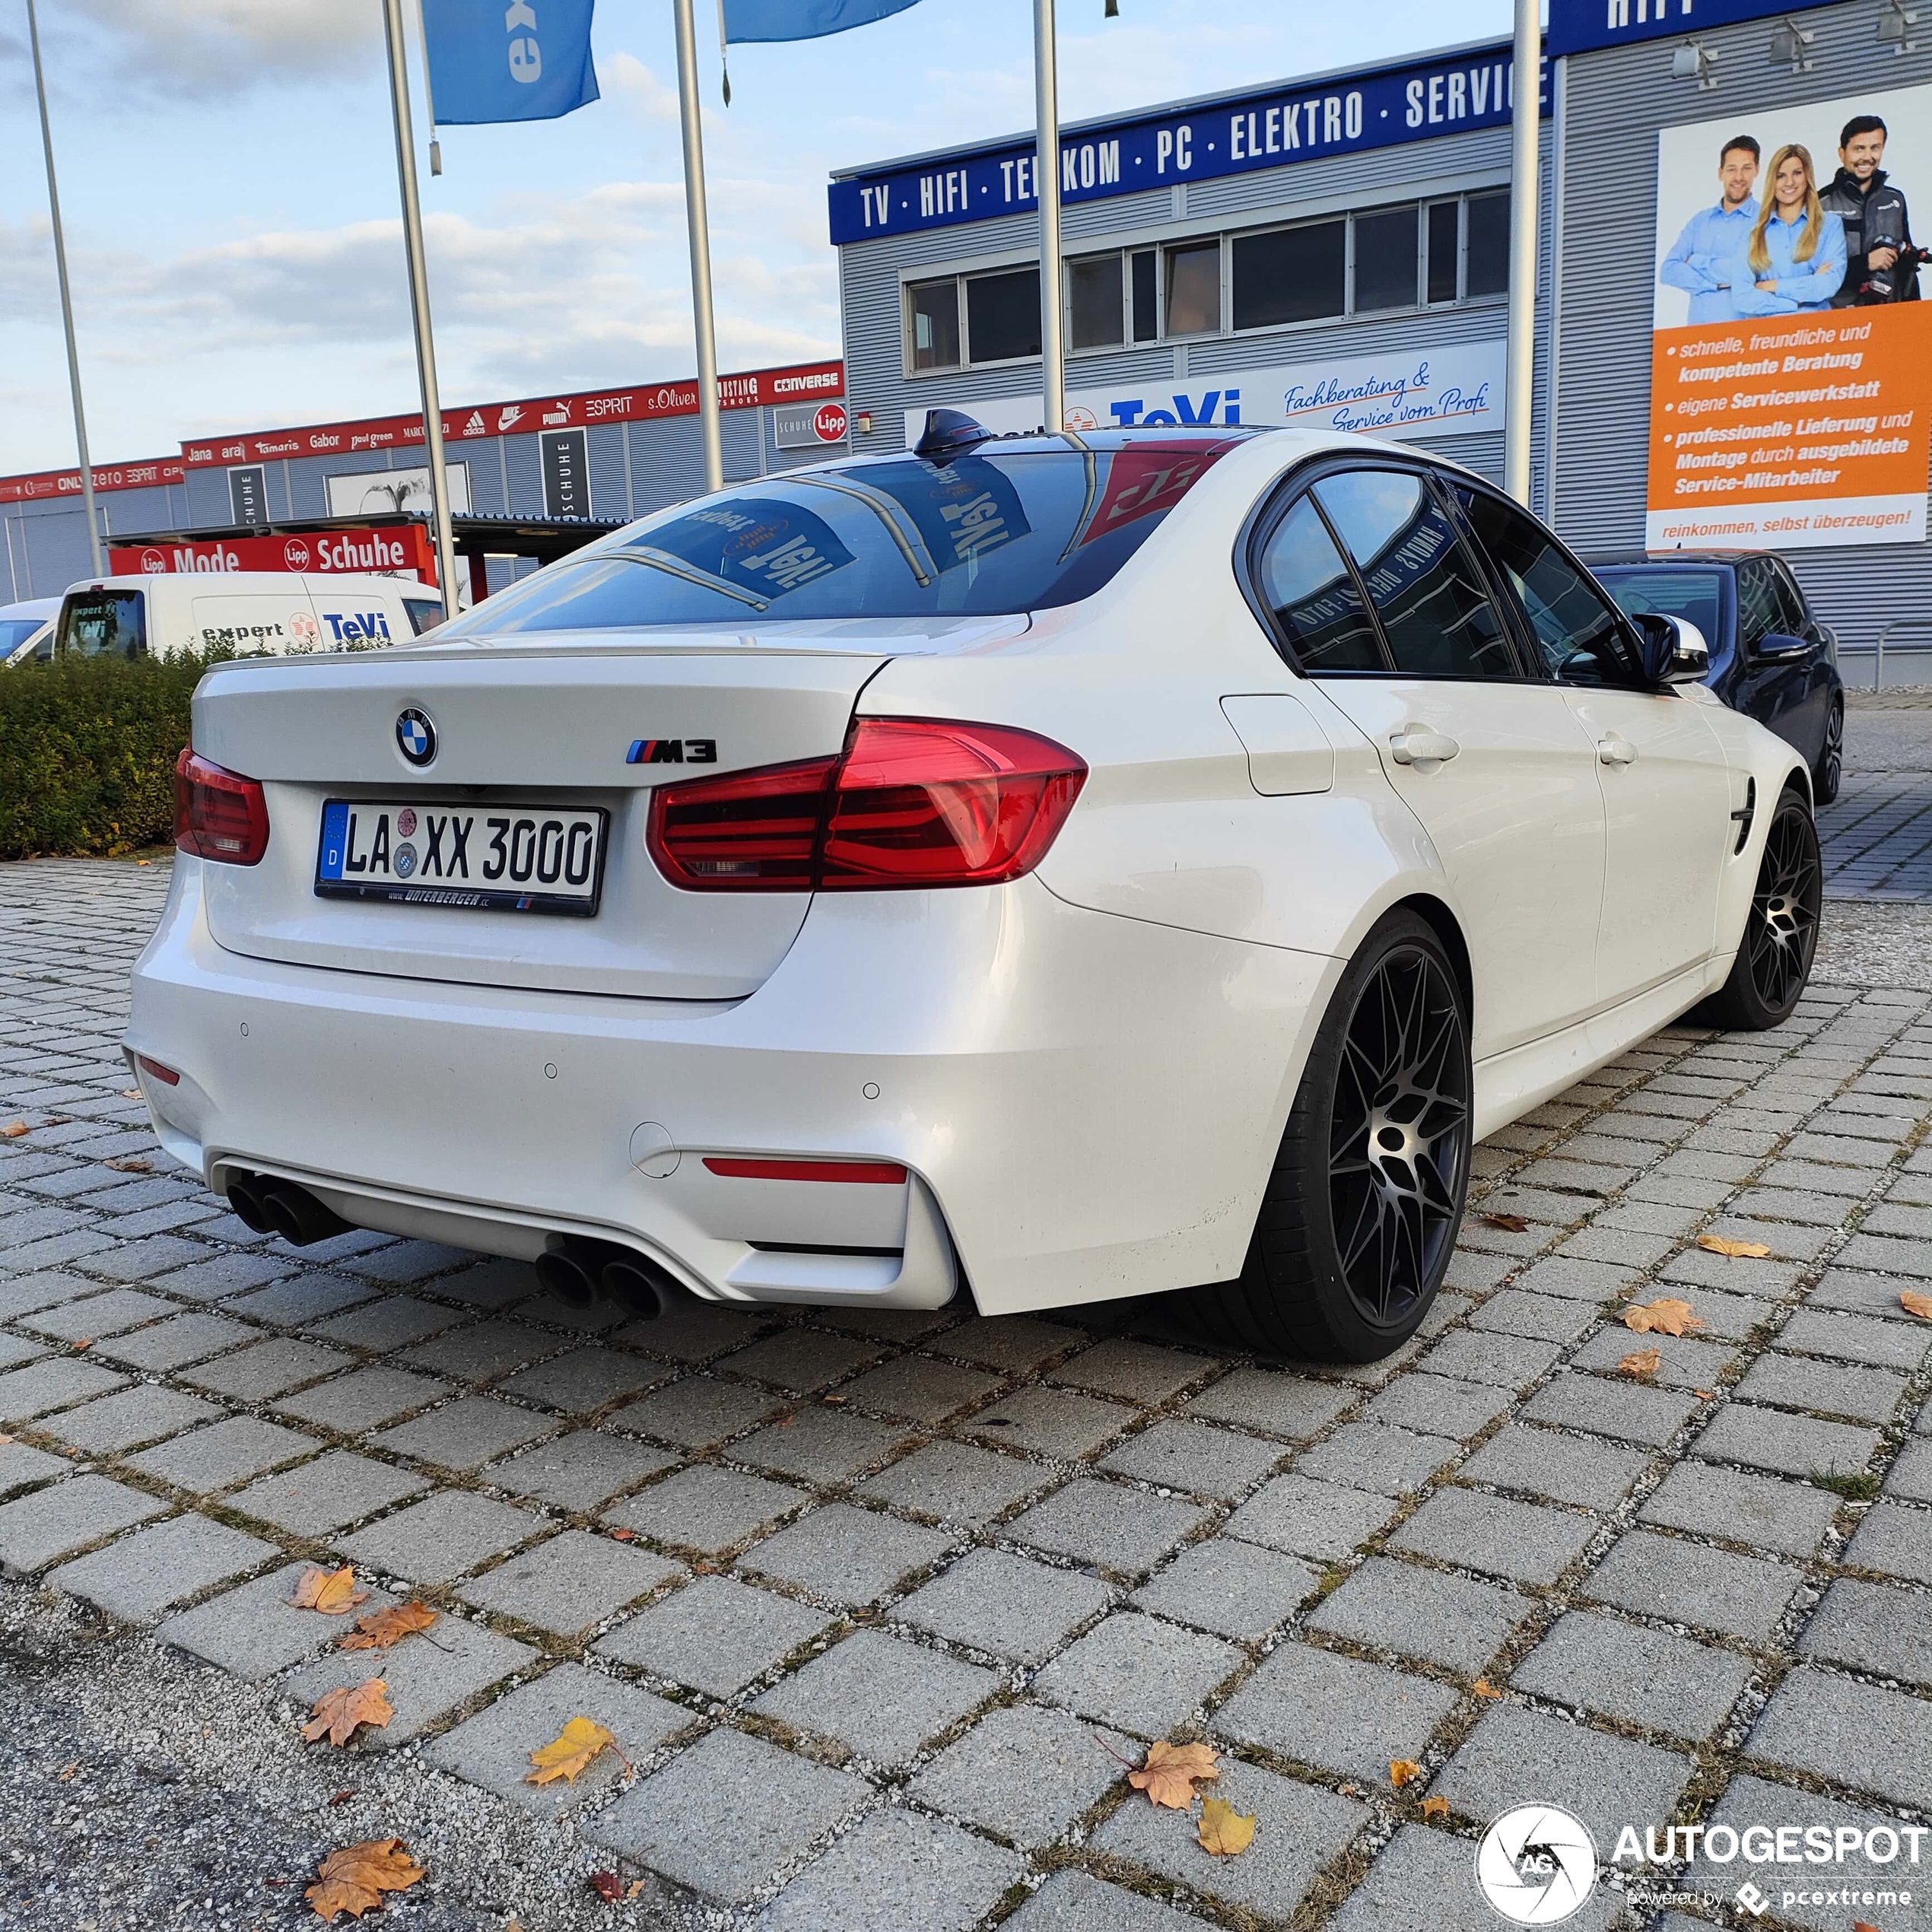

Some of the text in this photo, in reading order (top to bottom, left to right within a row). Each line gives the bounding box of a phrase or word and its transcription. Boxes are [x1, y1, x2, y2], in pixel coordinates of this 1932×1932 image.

[860, 184, 889, 227] TV
[920, 170, 968, 217] HIFI
[1000, 140, 1120, 202] TEKOM
[1157, 126, 1193, 174] PC
[1231, 91, 1363, 160] ELEKTRO
[1679, 323, 1871, 358] schnelle, freundliche und
[774, 372, 838, 392] CONVERSE
[1679, 351, 1864, 383] kompetente Beratung
[648, 389, 696, 410] s.Oliver
[1284, 362, 1430, 408] Fachberatung &
[1677, 380, 1880, 416] eigene Servicewerkstatt
[502, 405, 520, 420] NIKE
[542, 412, 567, 425] PUMA
[586, 396, 633, 417] ESPRIT
[1332, 383, 1489, 431] Service vom Profi
[462, 426, 485, 436] adidas
[779, 414, 845, 433] SCHUHE Lipp
[1676, 410, 1913, 448] professionelle Lieferung und
[188, 448, 212, 462] Jana
[221, 446, 241, 458] ara
[310, 433, 339, 448] Gabor
[351, 432, 369, 450] paul
[370, 432, 392, 448] green
[1676, 437, 1909, 472] Montage durch ausgebildete
[92, 472, 122, 486] zero
[126, 467, 157, 483] ESPRIT
[558, 443, 574, 512] SCHUHE
[1674, 466, 1841, 494] Service-Mitarbeiter
[241, 476, 256, 525] CHUHE
[1662, 510, 1911, 539] reinkommen, selbst überzeugen!
[143, 544, 240, 574] Lipp Mode
[286, 534, 404, 570] Lipp Schuhe
[202, 612, 390, 641] expert TeVi
[647, 739, 717, 763] M3
[328, 850, 337, 866] D
[345, 813, 389, 873] LA
[421, 815, 474, 878] XX
[483, 818, 593, 885] 3000
